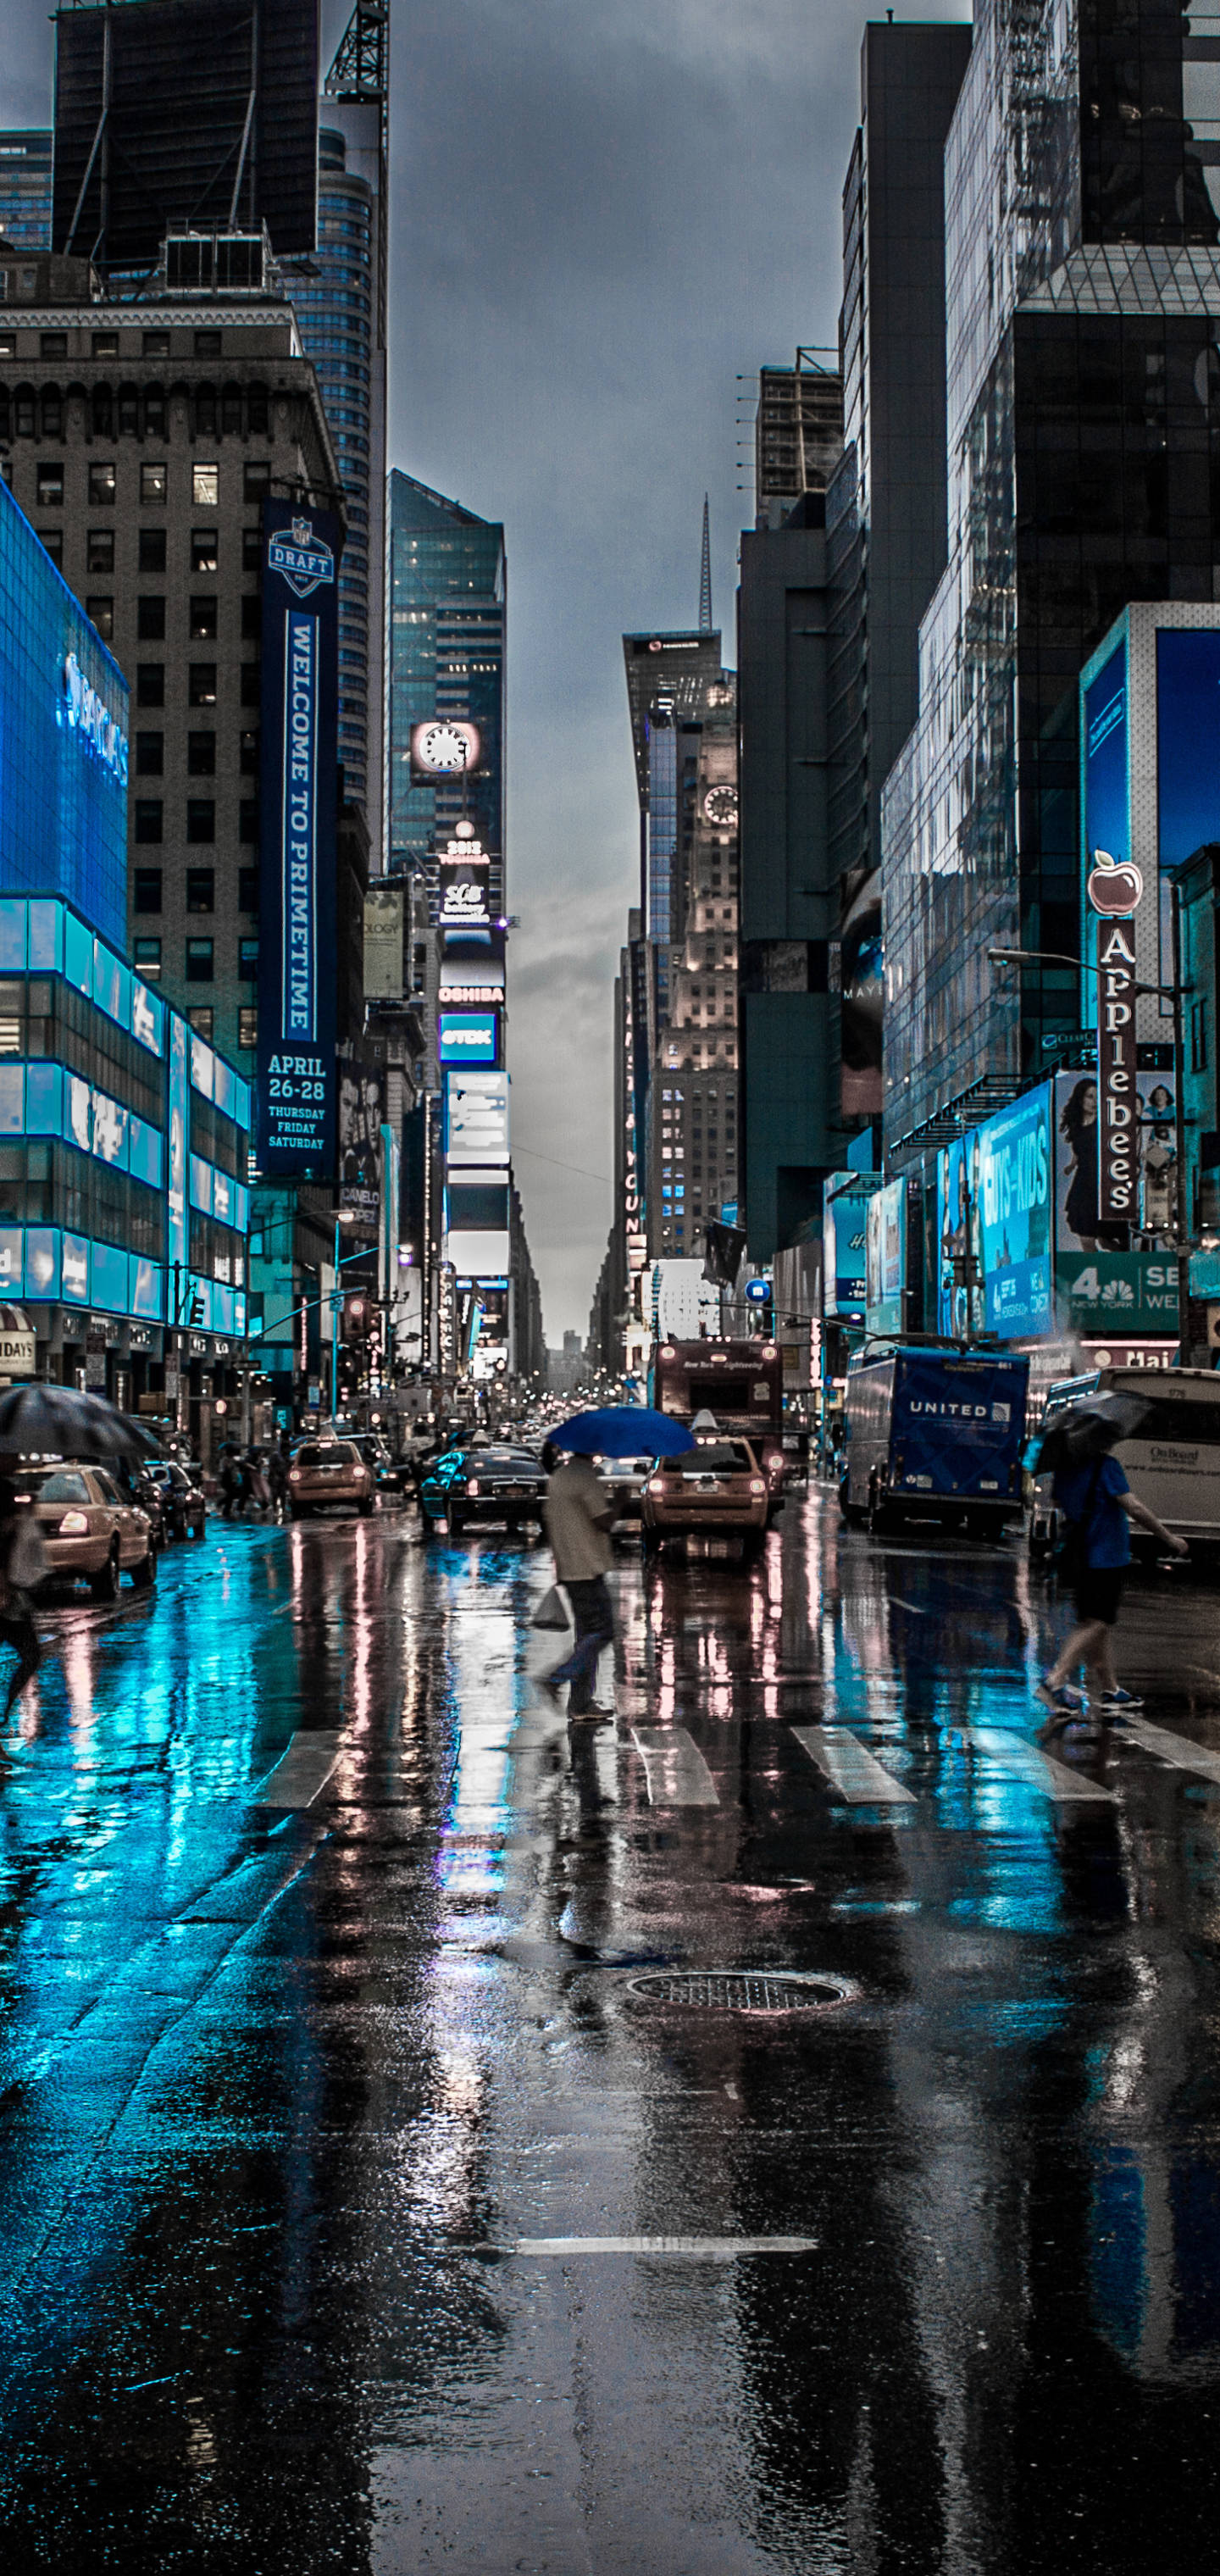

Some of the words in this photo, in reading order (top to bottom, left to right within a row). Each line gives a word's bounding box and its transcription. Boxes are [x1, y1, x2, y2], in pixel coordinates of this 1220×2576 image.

[274, 548, 328, 574] DRAFT
[291, 625, 311, 782] WELCOME
[291, 791, 308, 832] TO
[291, 841, 308, 1030] PRIMETIME
[268, 1054, 326, 1078] APRIL
[1101, 928, 1136, 1209] Applebee's
[269, 1078, 325, 1101] 26-28
[268, 1105, 325, 1120] THURSDAY
[277, 1121, 317, 1135] FRIDAY
[268, 1135, 325, 1150] SATURDAY
[1071, 1266, 1101, 1301] 4
[1072, 1301, 1099, 1309] NEW
[1101, 1301, 1134, 1309] YORK
[1145, 1294, 1179, 1309] WE
[910, 1401, 987, 1418] UNITED
